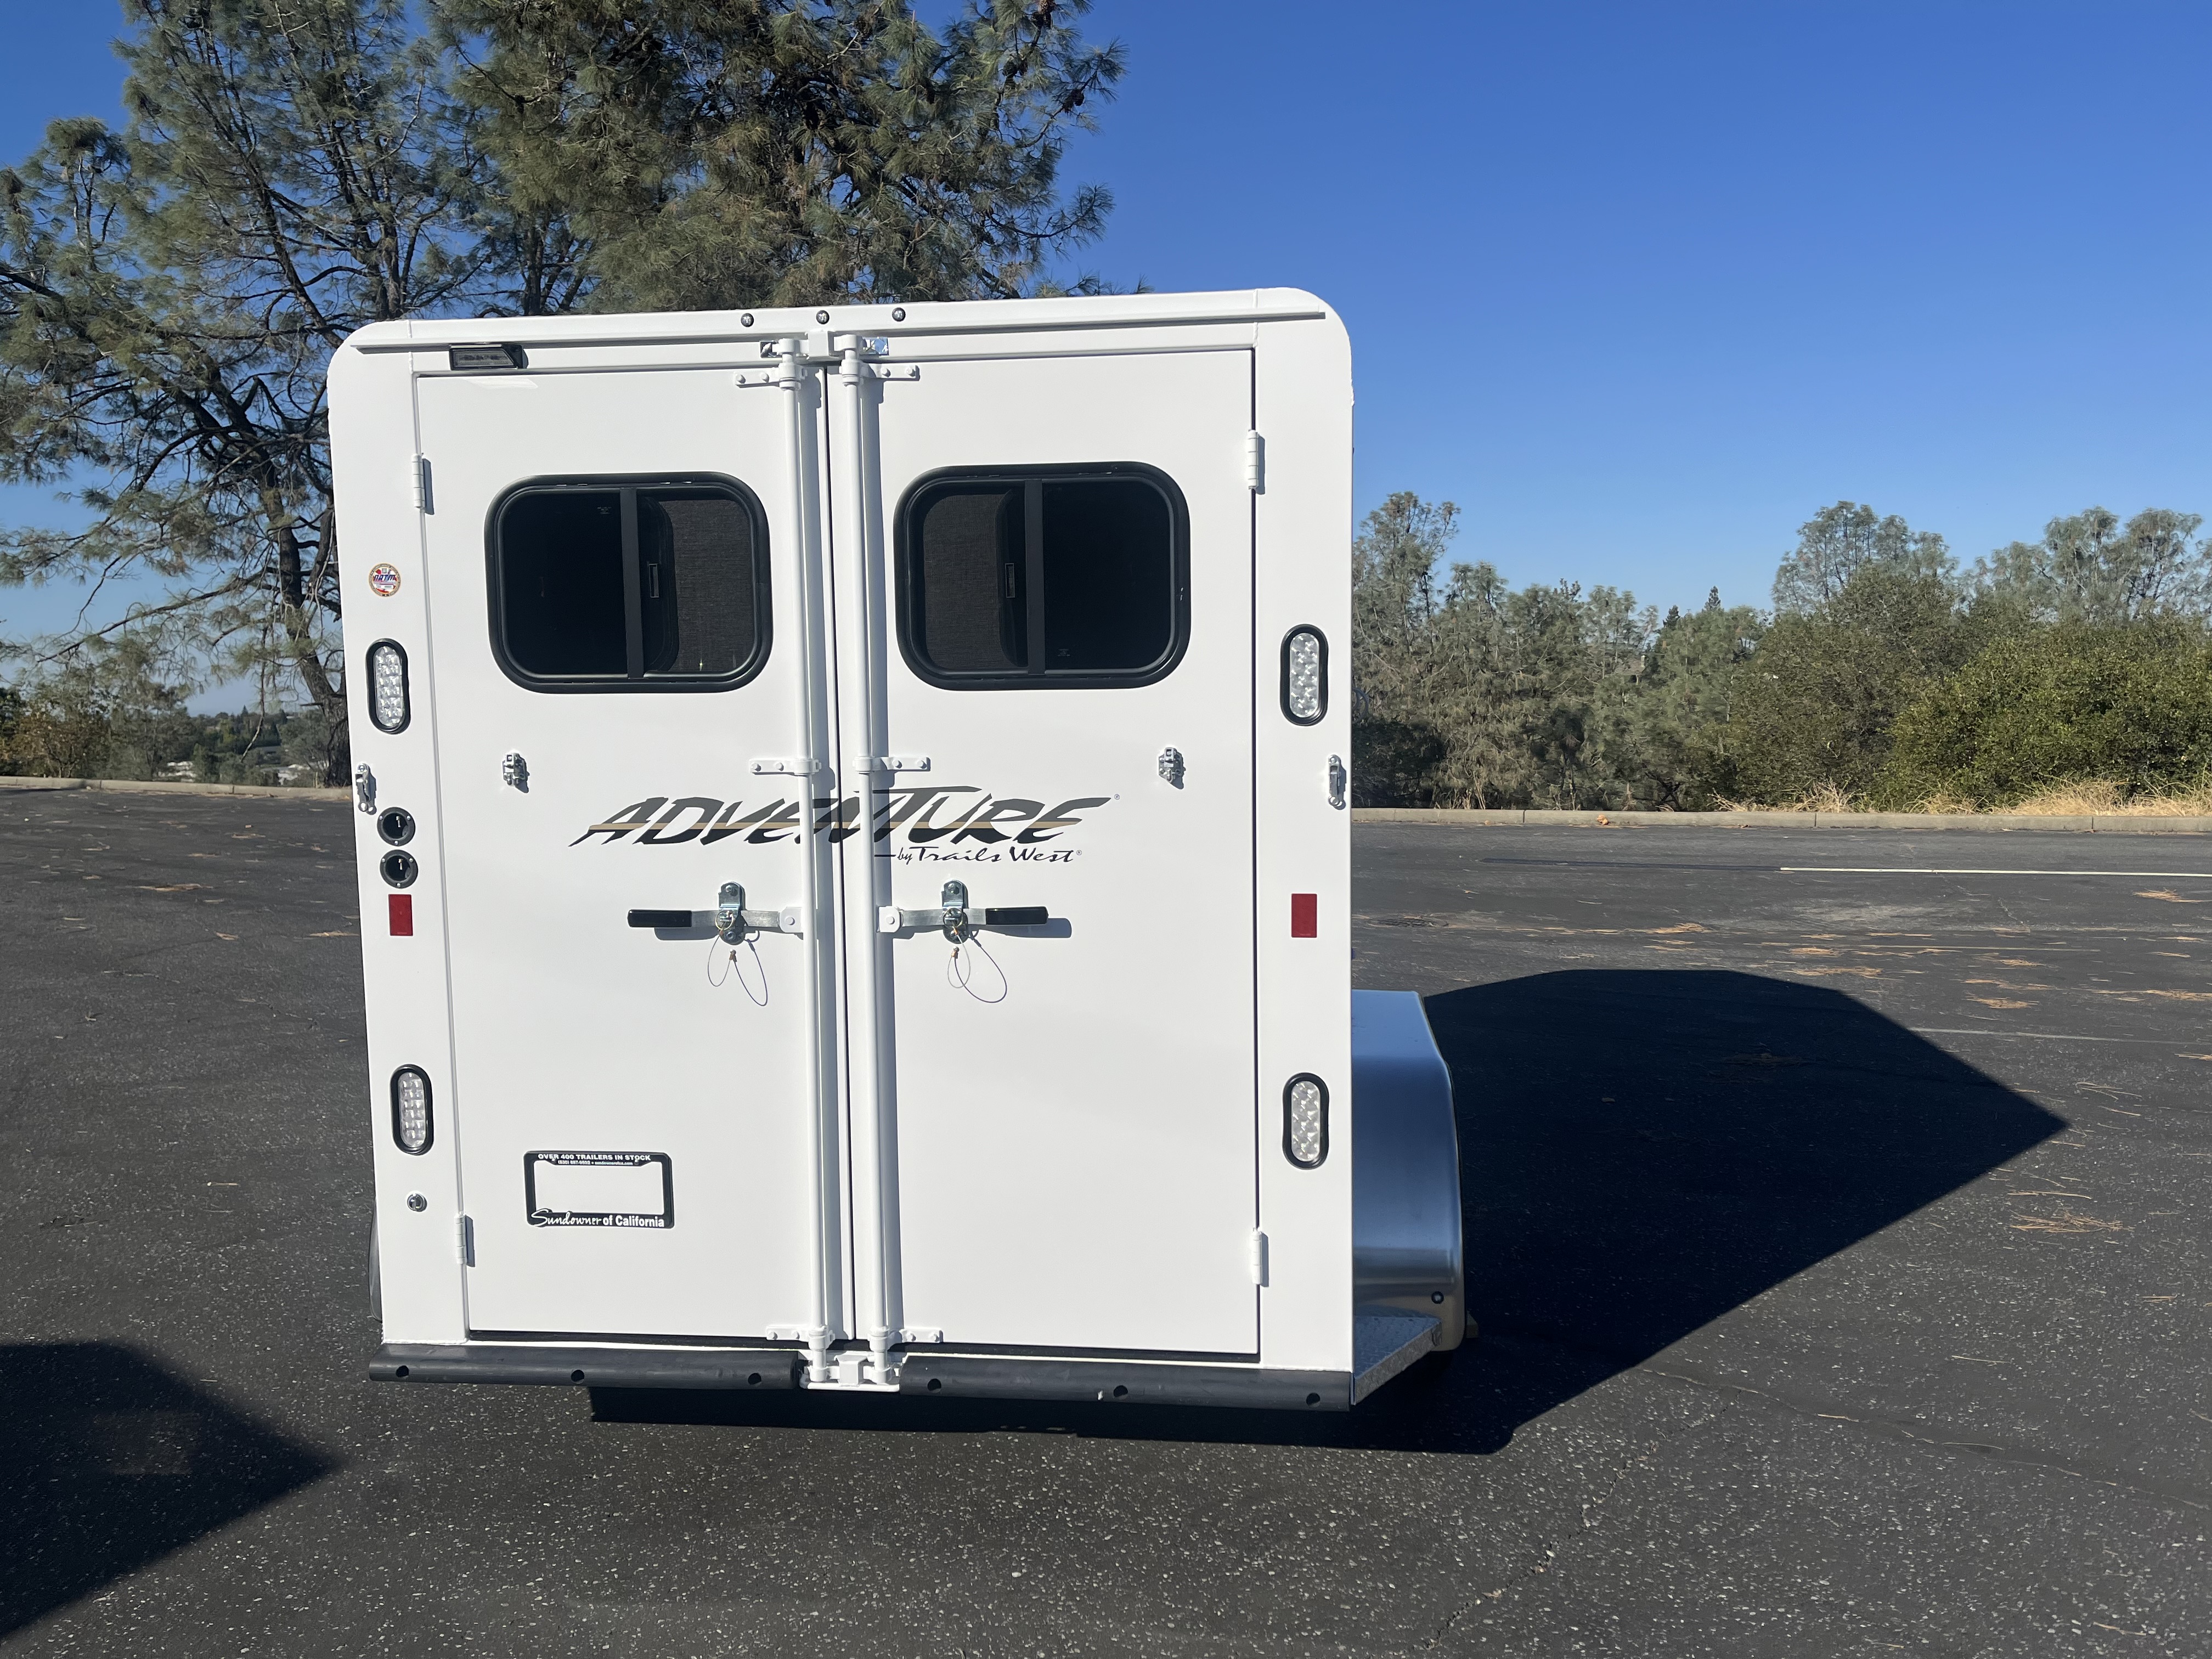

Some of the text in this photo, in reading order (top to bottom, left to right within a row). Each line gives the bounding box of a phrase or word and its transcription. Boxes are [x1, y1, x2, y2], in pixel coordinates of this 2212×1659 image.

[896, 846, 1074, 865] by Trails West
[531, 1209, 664, 1227] Sundowner of California
